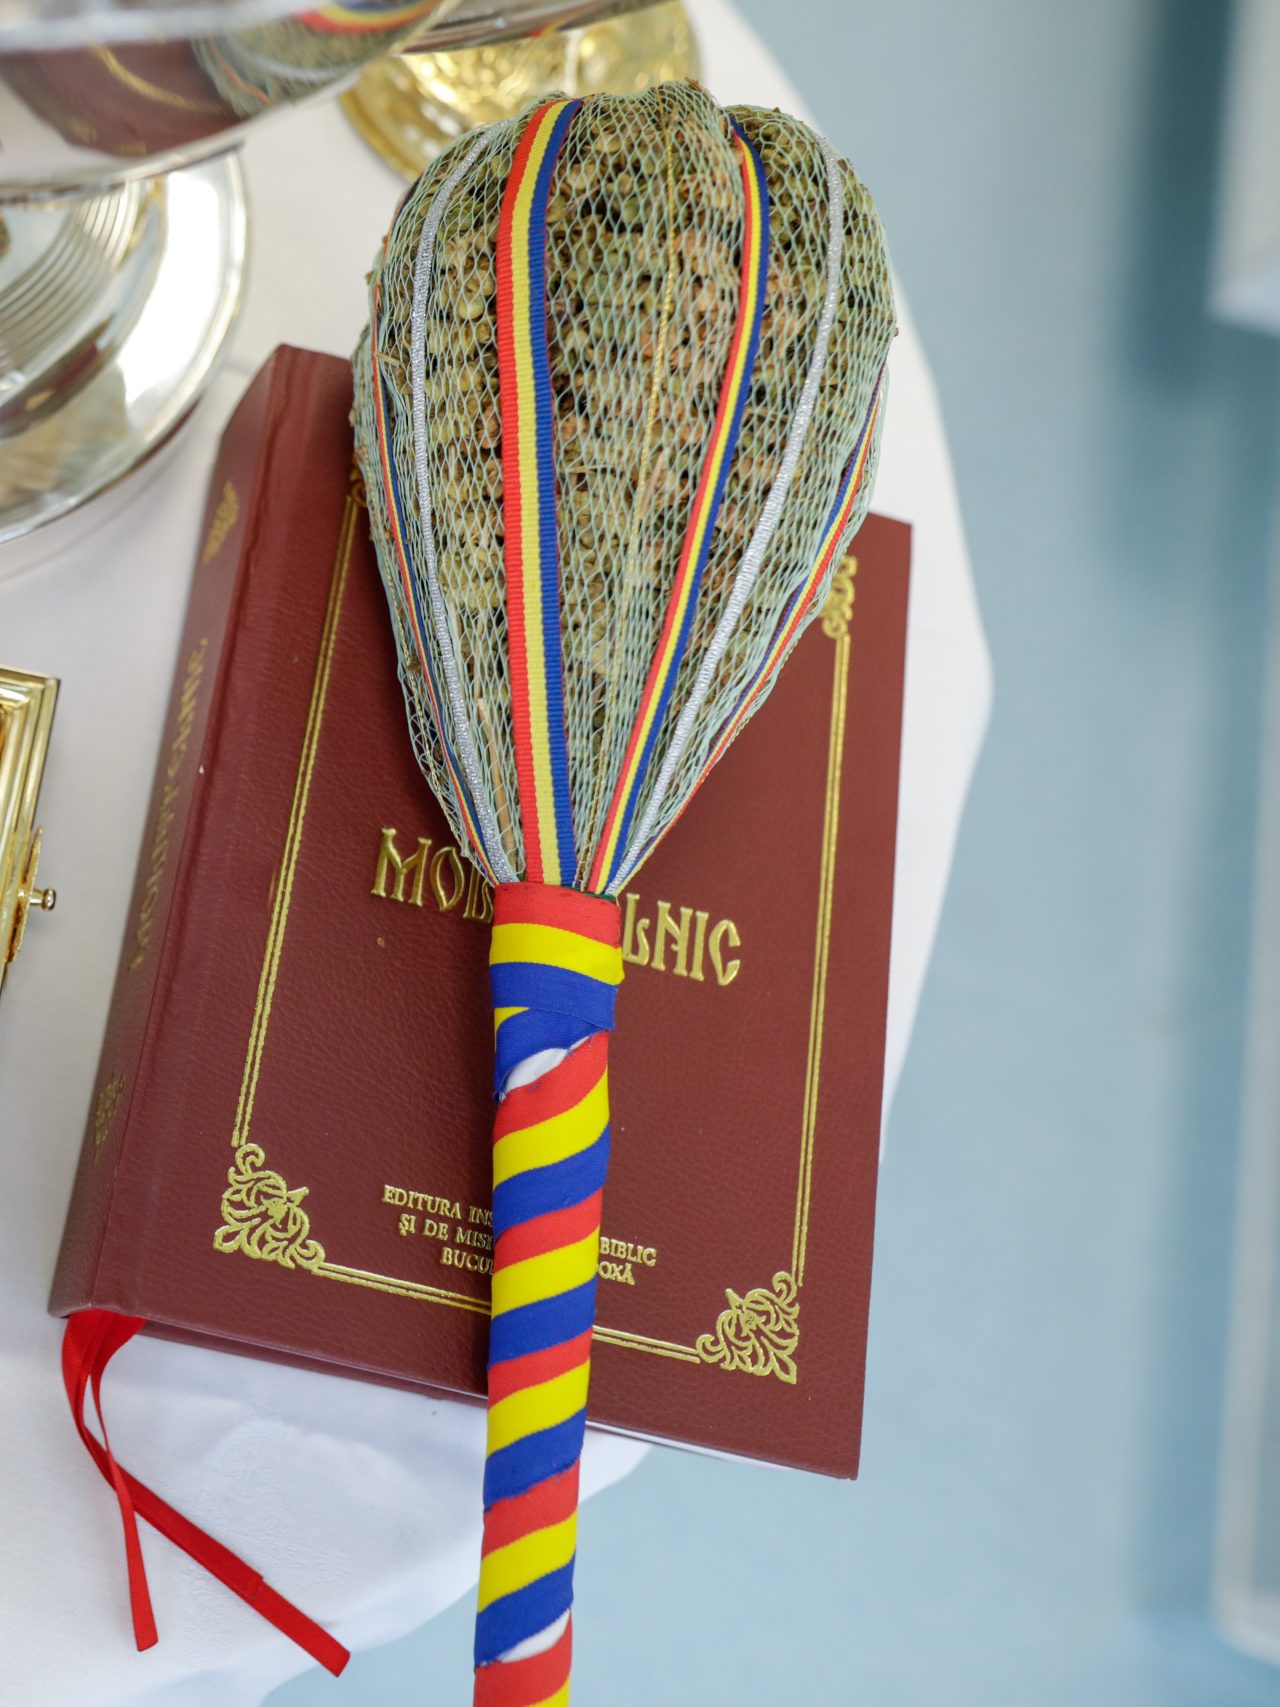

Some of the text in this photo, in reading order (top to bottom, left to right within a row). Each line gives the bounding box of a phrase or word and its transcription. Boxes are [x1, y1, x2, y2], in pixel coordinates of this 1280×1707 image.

[382, 1184, 462, 1219] EDITURA
[599, 1236, 657, 1267] BIBLIC
[422, 1219, 449, 1241] DE
